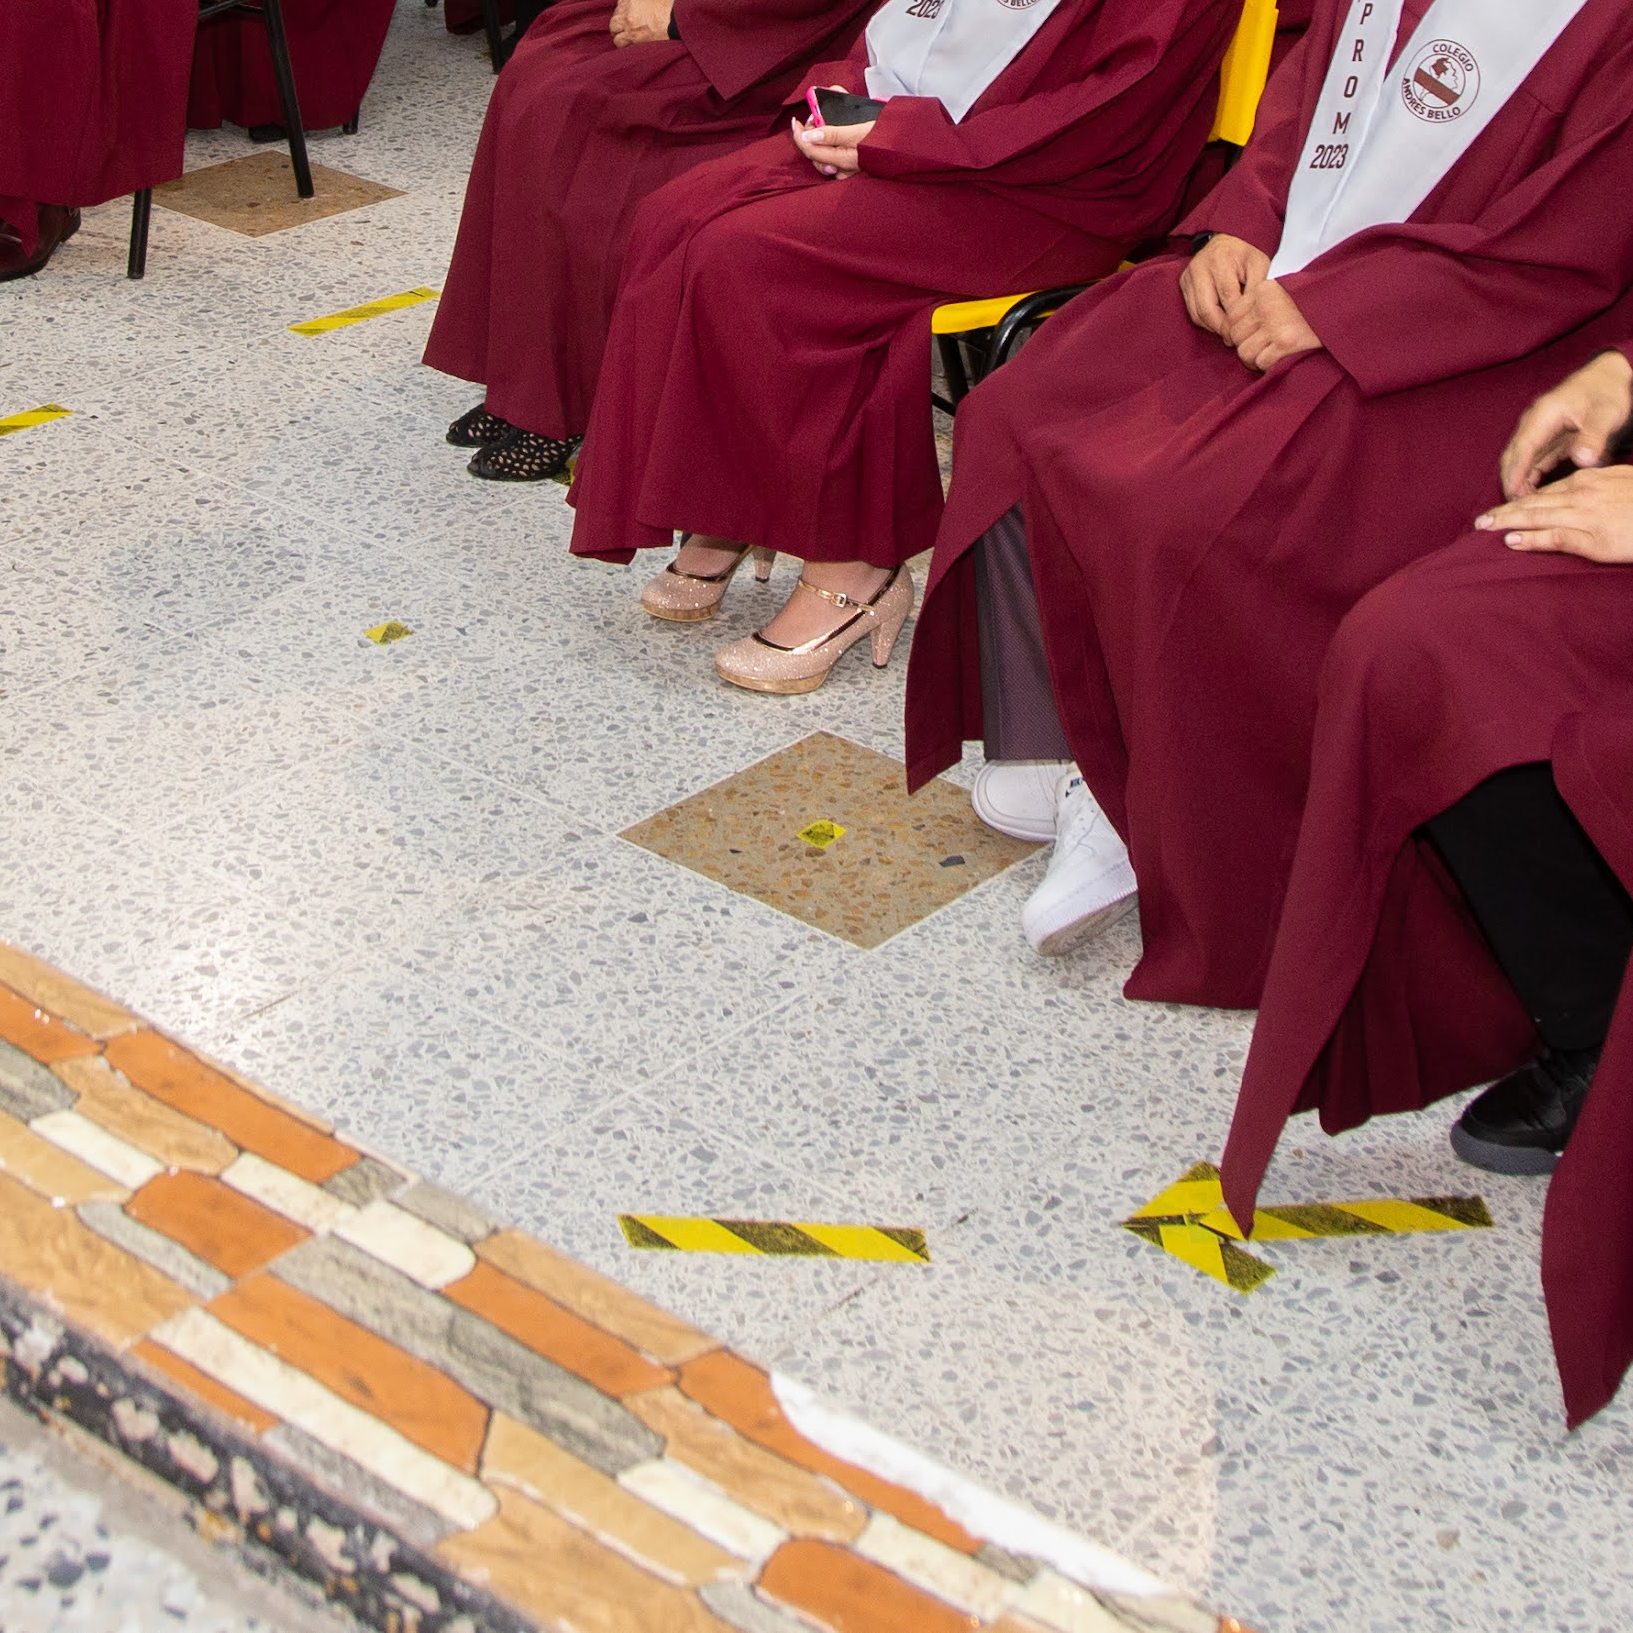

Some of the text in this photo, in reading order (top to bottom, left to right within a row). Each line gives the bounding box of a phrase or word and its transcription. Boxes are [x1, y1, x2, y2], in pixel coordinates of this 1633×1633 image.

[1332, 3, 1373, 134] PROM
[1432, 44, 1474, 72] COLEGIO
[1403, 78, 1461, 120] ANDRES BELLO
[1309, 144, 1349, 169] 2023
